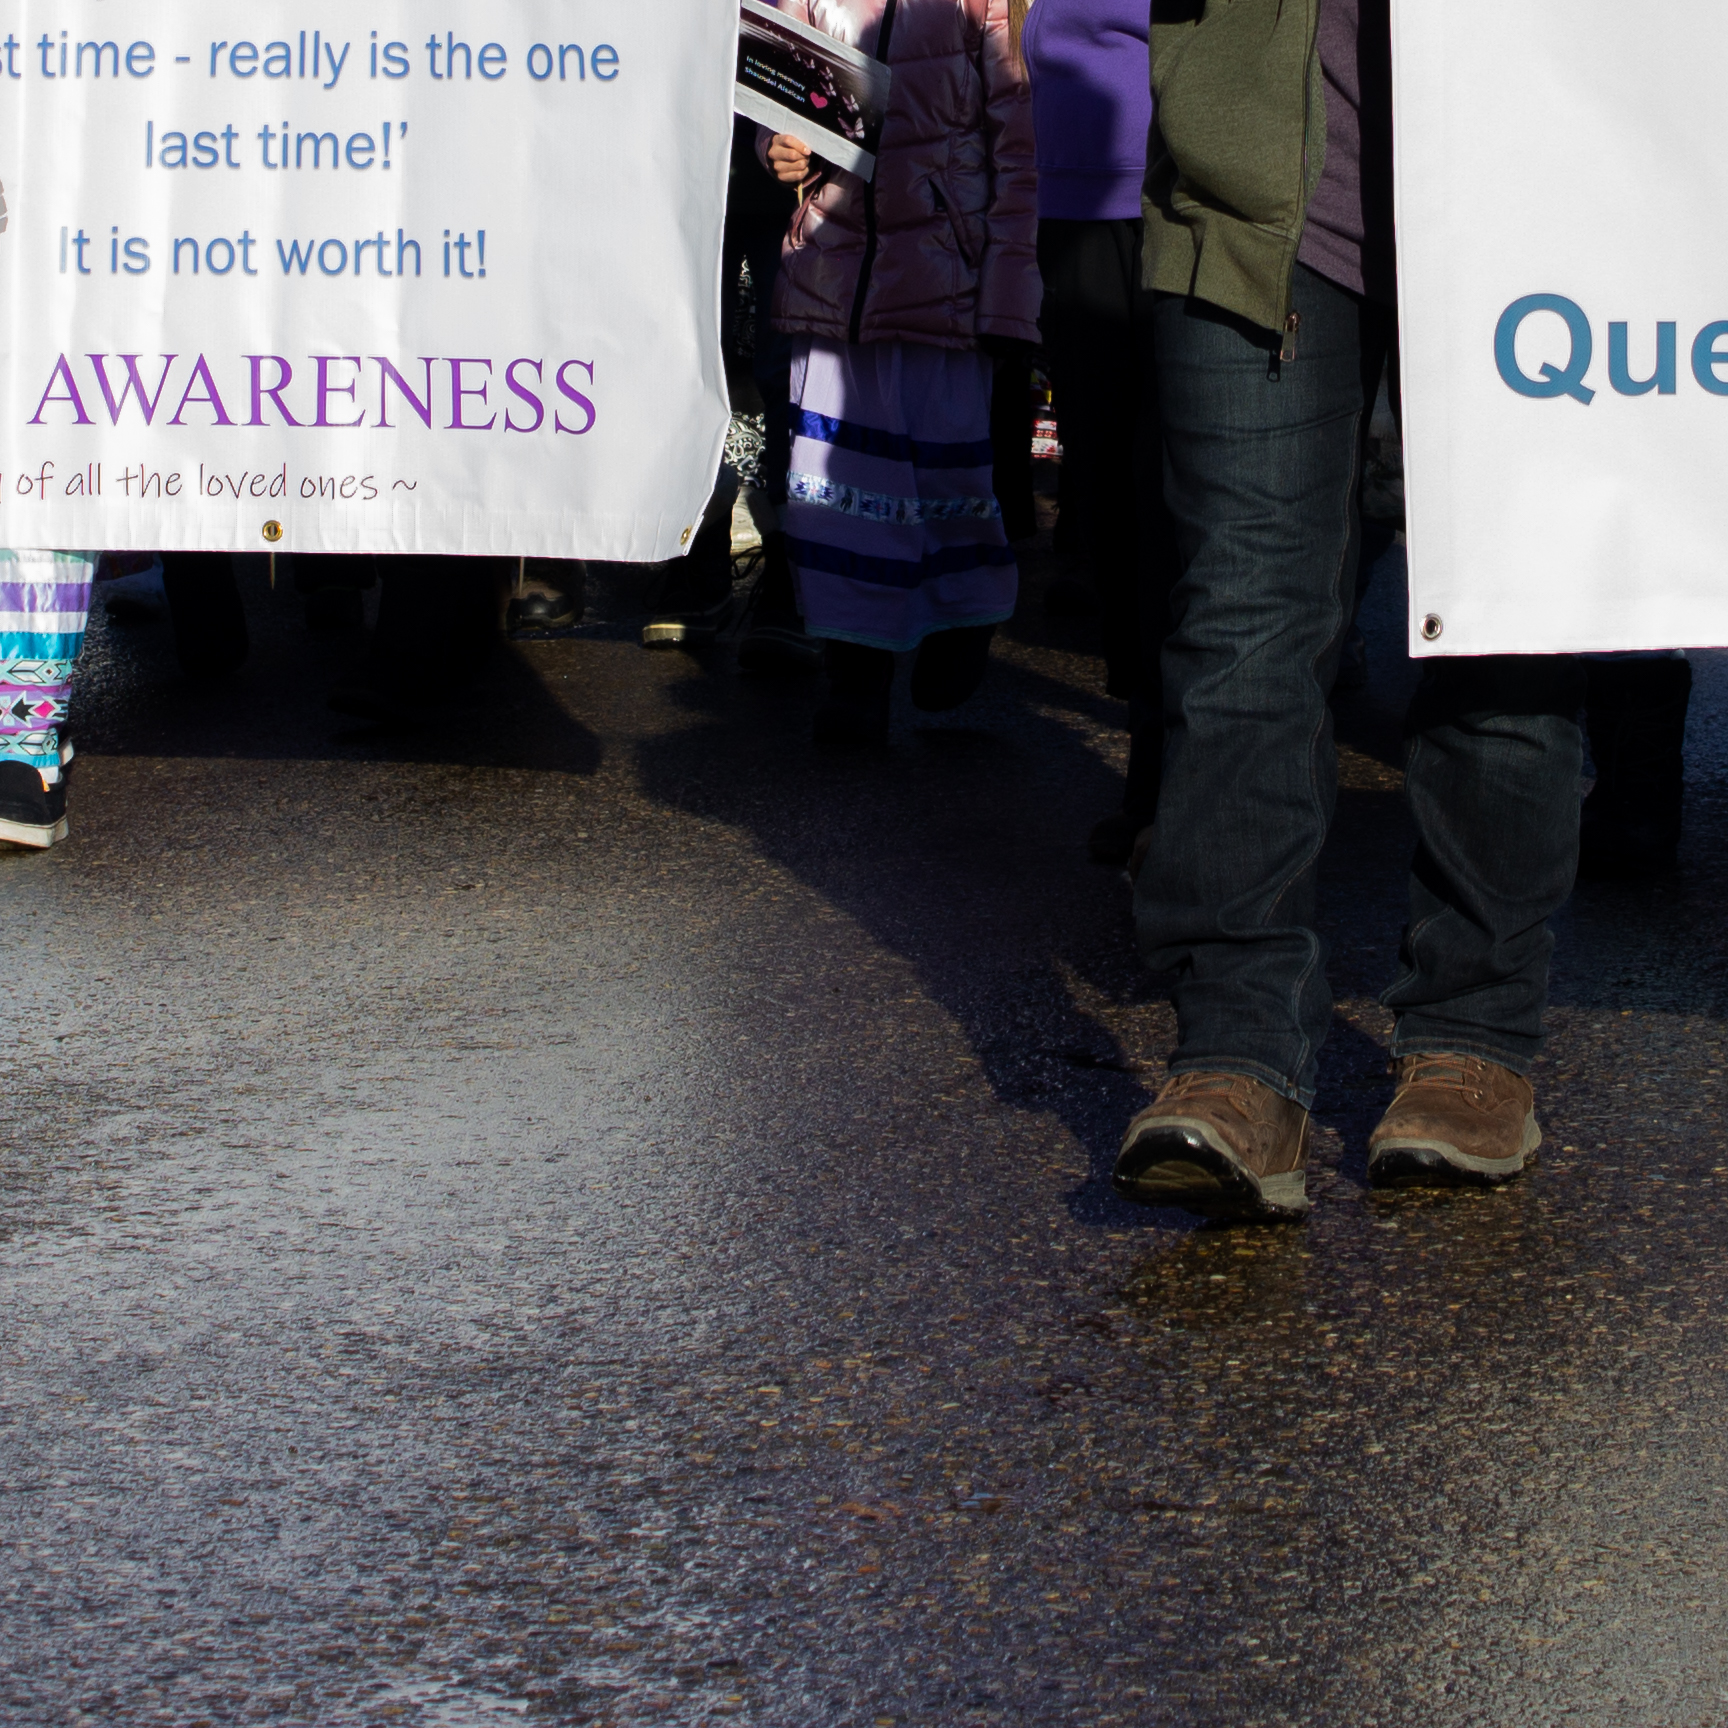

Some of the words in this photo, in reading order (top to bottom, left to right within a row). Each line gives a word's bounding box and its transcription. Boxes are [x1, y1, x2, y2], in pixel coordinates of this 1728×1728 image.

[37, 31, 155, 78] time
[210, 30, 350, 88] really
[370, 30, 410, 79] is
[425, 31, 508, 80] the
[526, 43, 620, 80] one
[145, 121, 240, 168] last
[59, 226, 90, 274] It
[110, 226, 150, 274] is
[172, 230, 257, 275] not
[276, 228, 422, 276] worth
[443, 228, 487, 277] it!
[28, 354, 596, 435] AWARENESS
[16, 461, 55, 501] of
[65, 462, 102, 497] all
[117, 463, 184, 499] the
[199, 462, 288, 500] loved
[300, 475, 379, 501] ones
